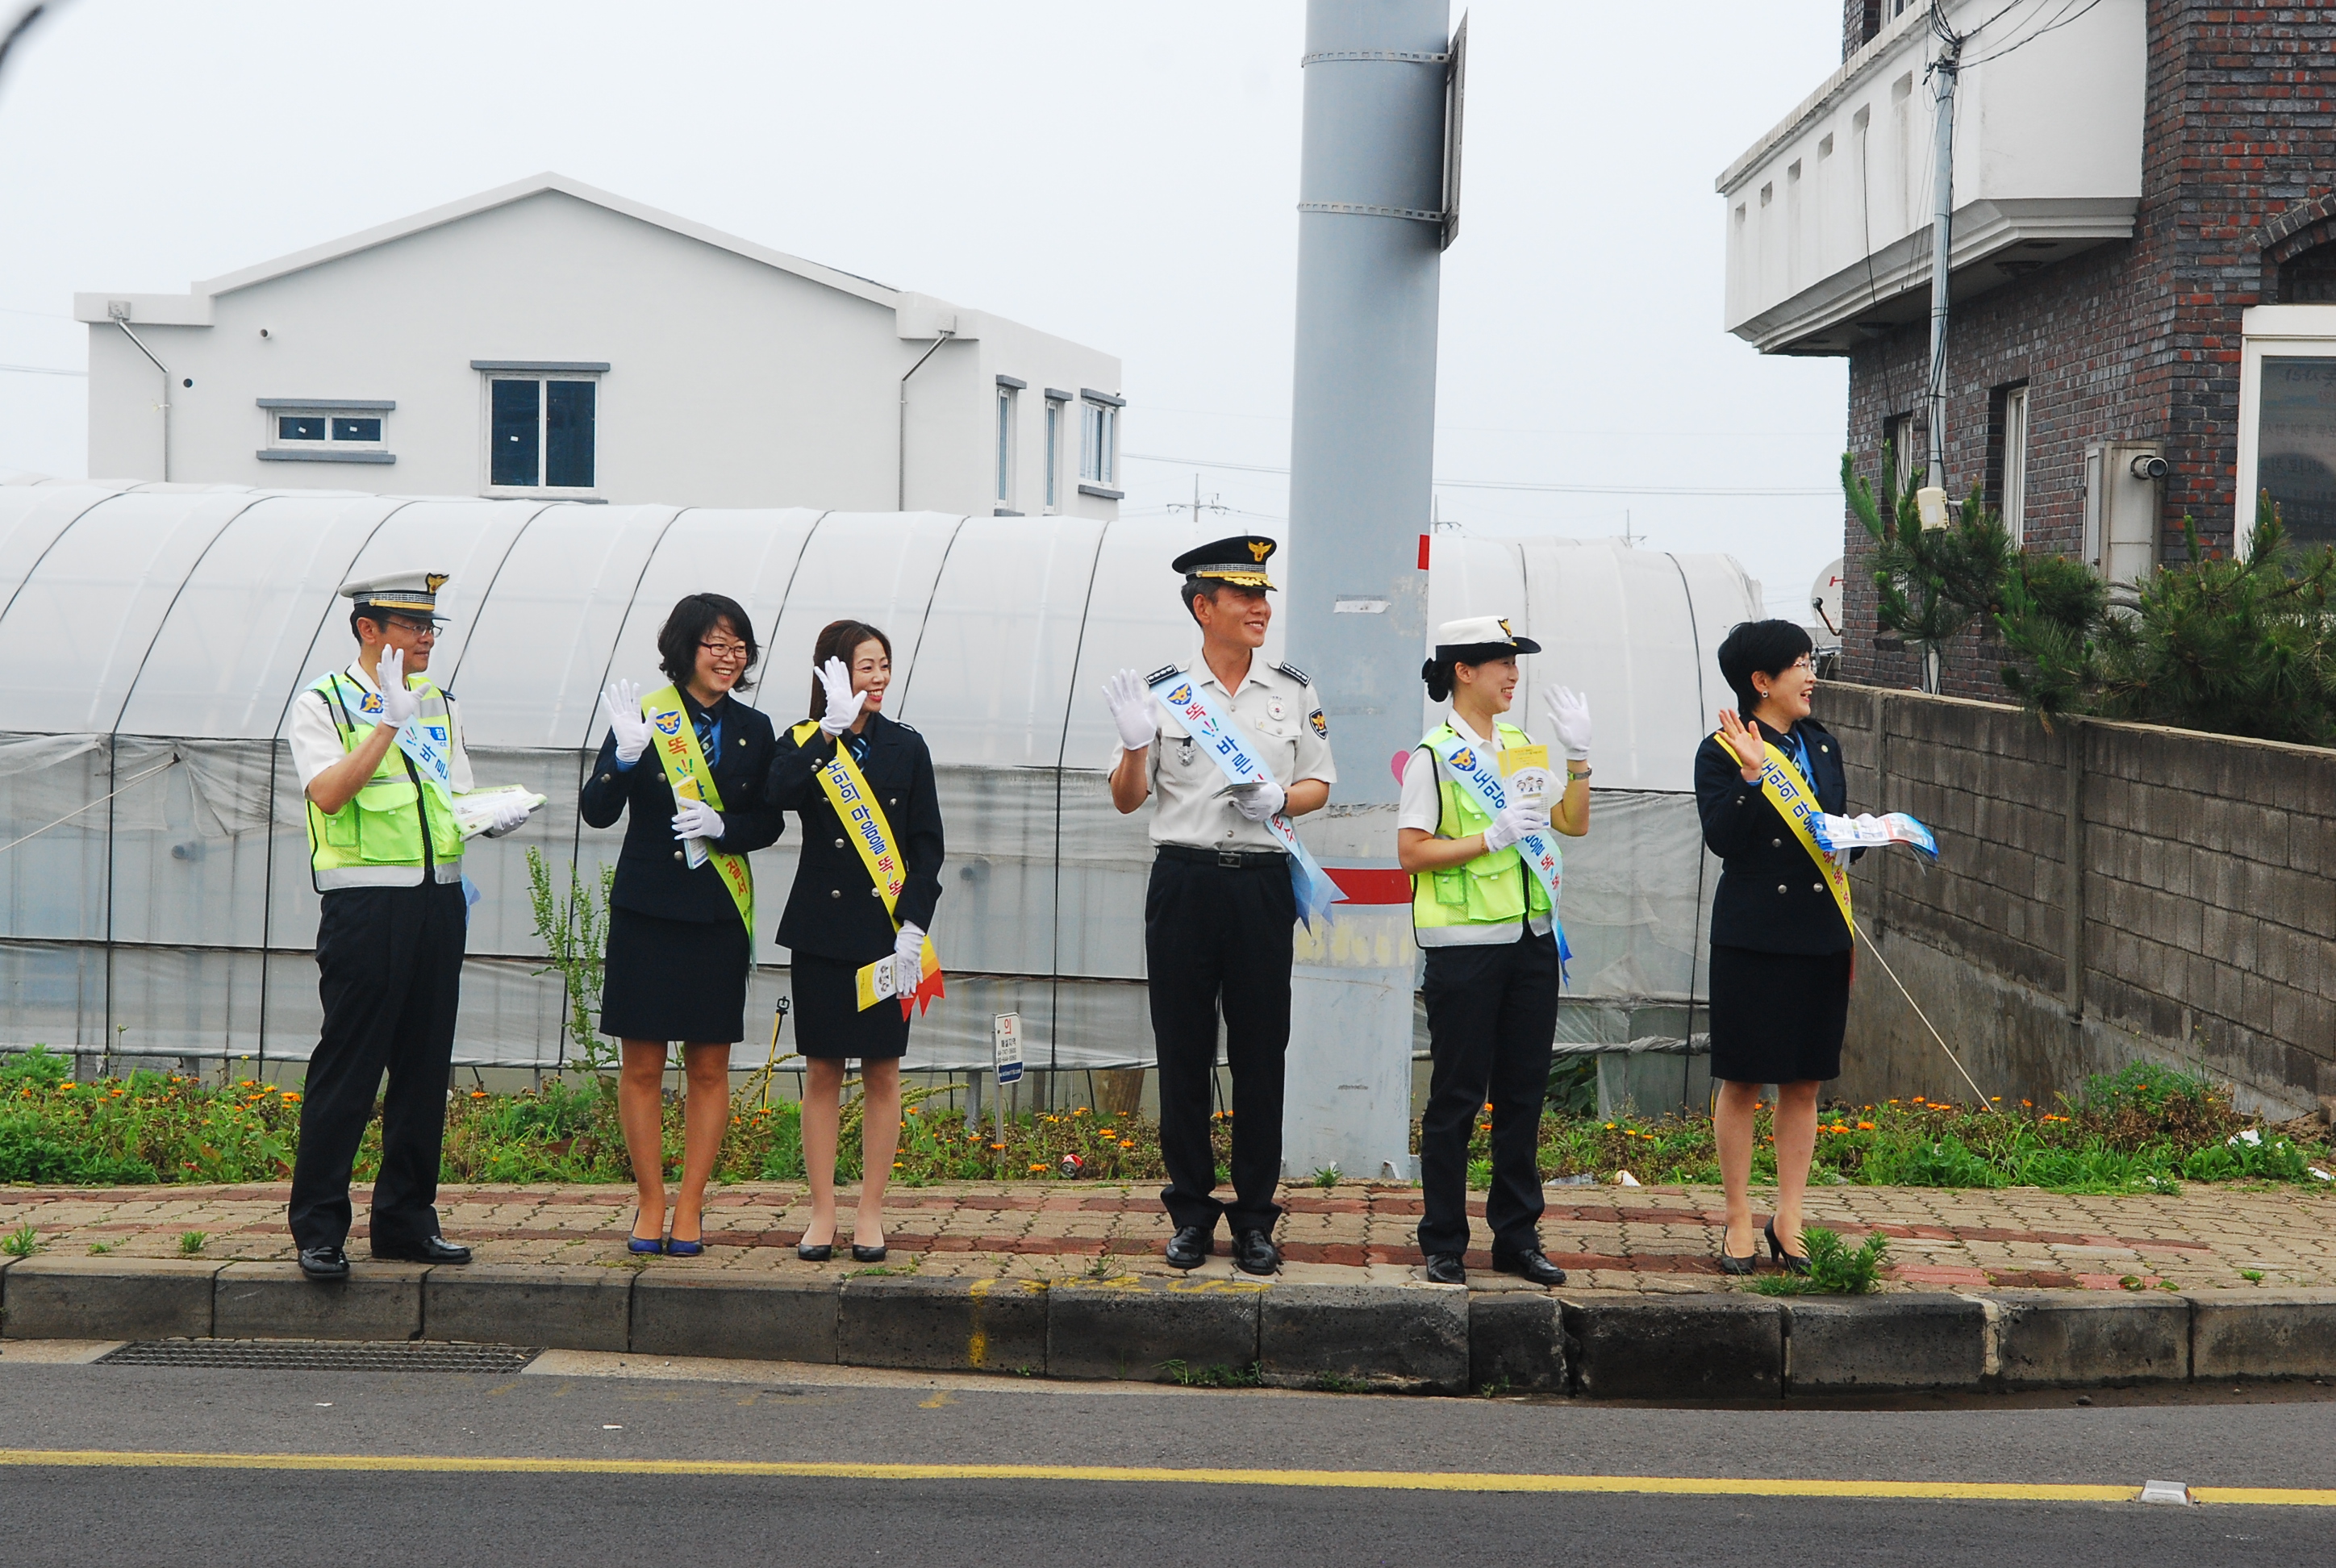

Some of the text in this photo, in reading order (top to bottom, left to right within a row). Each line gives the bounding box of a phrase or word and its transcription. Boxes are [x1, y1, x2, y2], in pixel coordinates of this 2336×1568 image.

[668, 736, 687, 754] 똑
[1216, 736, 1254, 775] 바른
[851, 805, 886, 856] 마음을
